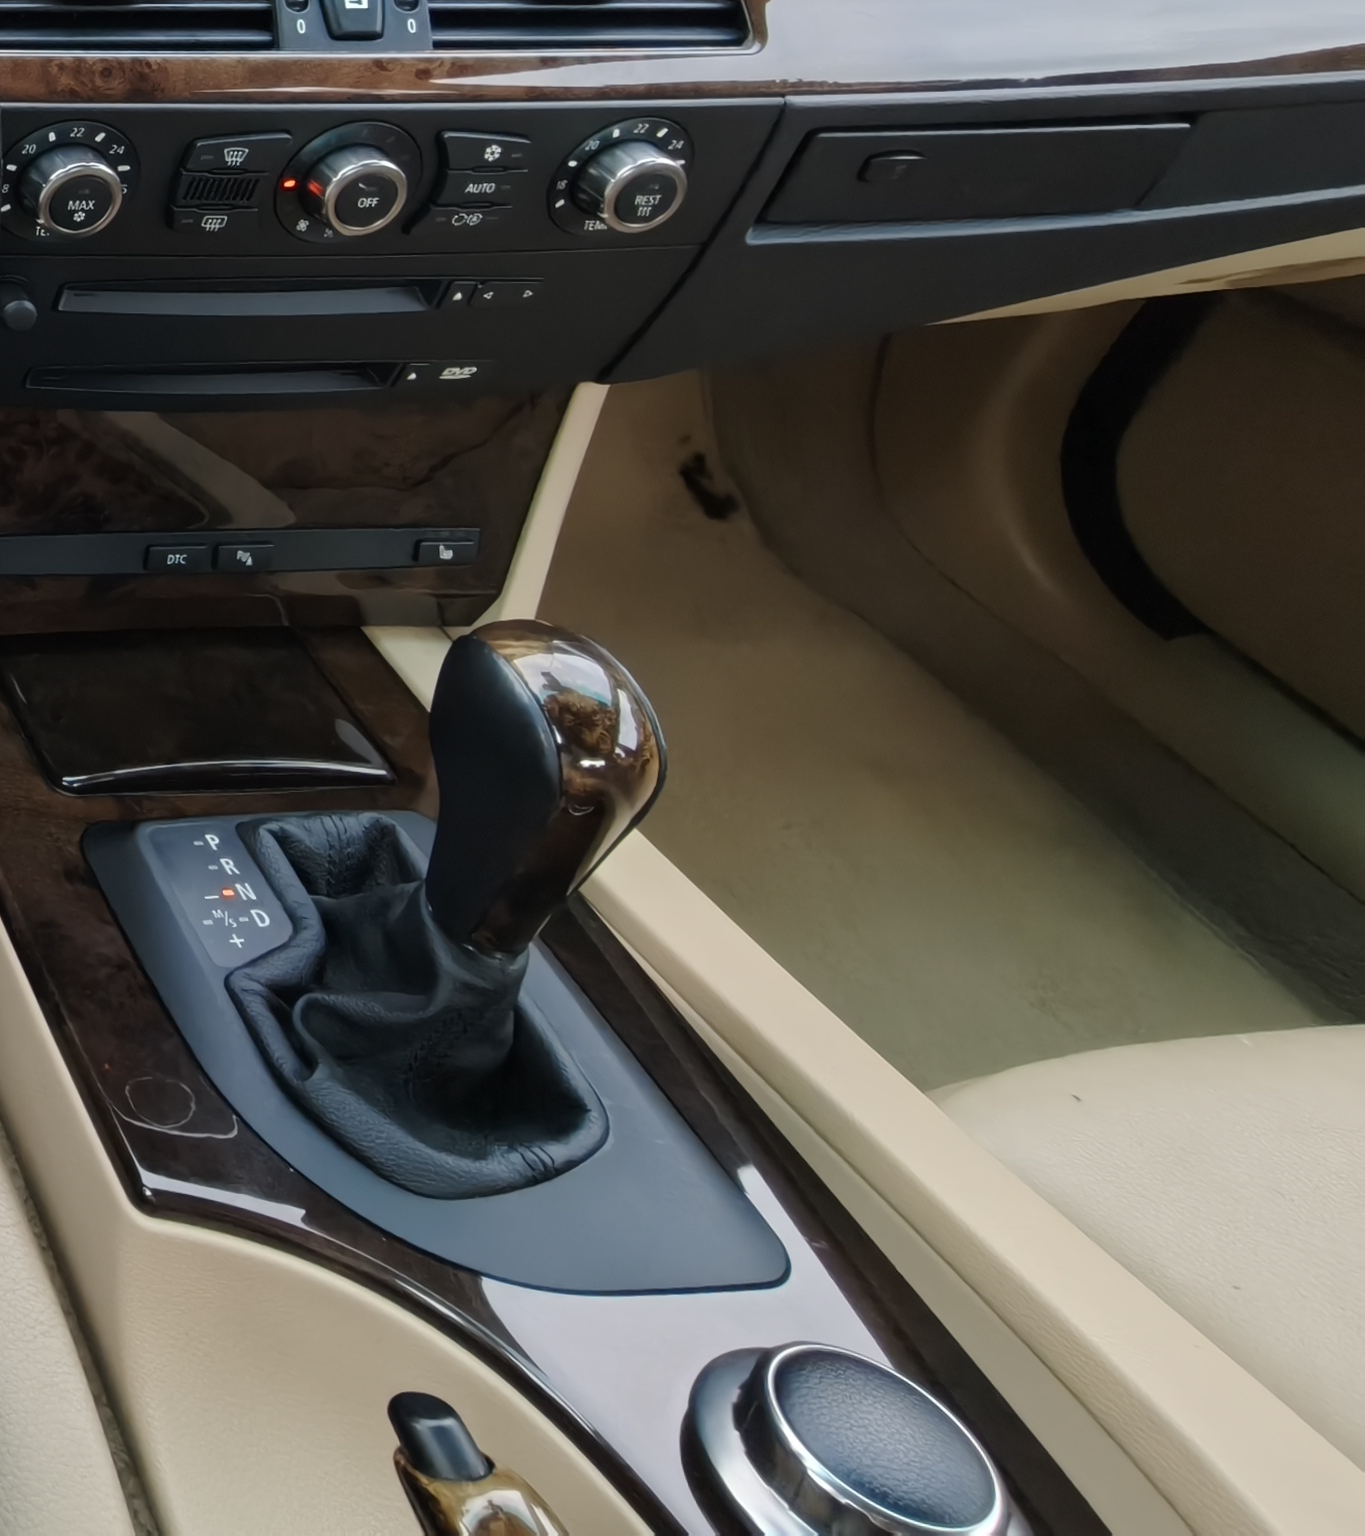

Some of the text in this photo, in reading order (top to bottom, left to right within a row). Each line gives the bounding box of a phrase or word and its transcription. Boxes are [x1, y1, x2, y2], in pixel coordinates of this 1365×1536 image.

[70, 127, 85, 138] 22
[633, 123, 649, 134] 22
[21, 144, 36, 154] 20
[109, 144, 125, 154] 24
[585, 140, 600, 151] 20
[668, 140, 684, 150] 24
[464, 183, 496, 194] AUTO
[68, 200, 95, 211] MAX
[357, 197, 380, 208] OFF
[635, 194, 662, 206] REST
[439, 366, 477, 377] DVD
[167, 554, 187, 565] DTC
[204, 833, 220, 851] P
[220, 857, 240, 875] R
[235, 883, 257, 901] N
[250, 909, 270, 927] D
